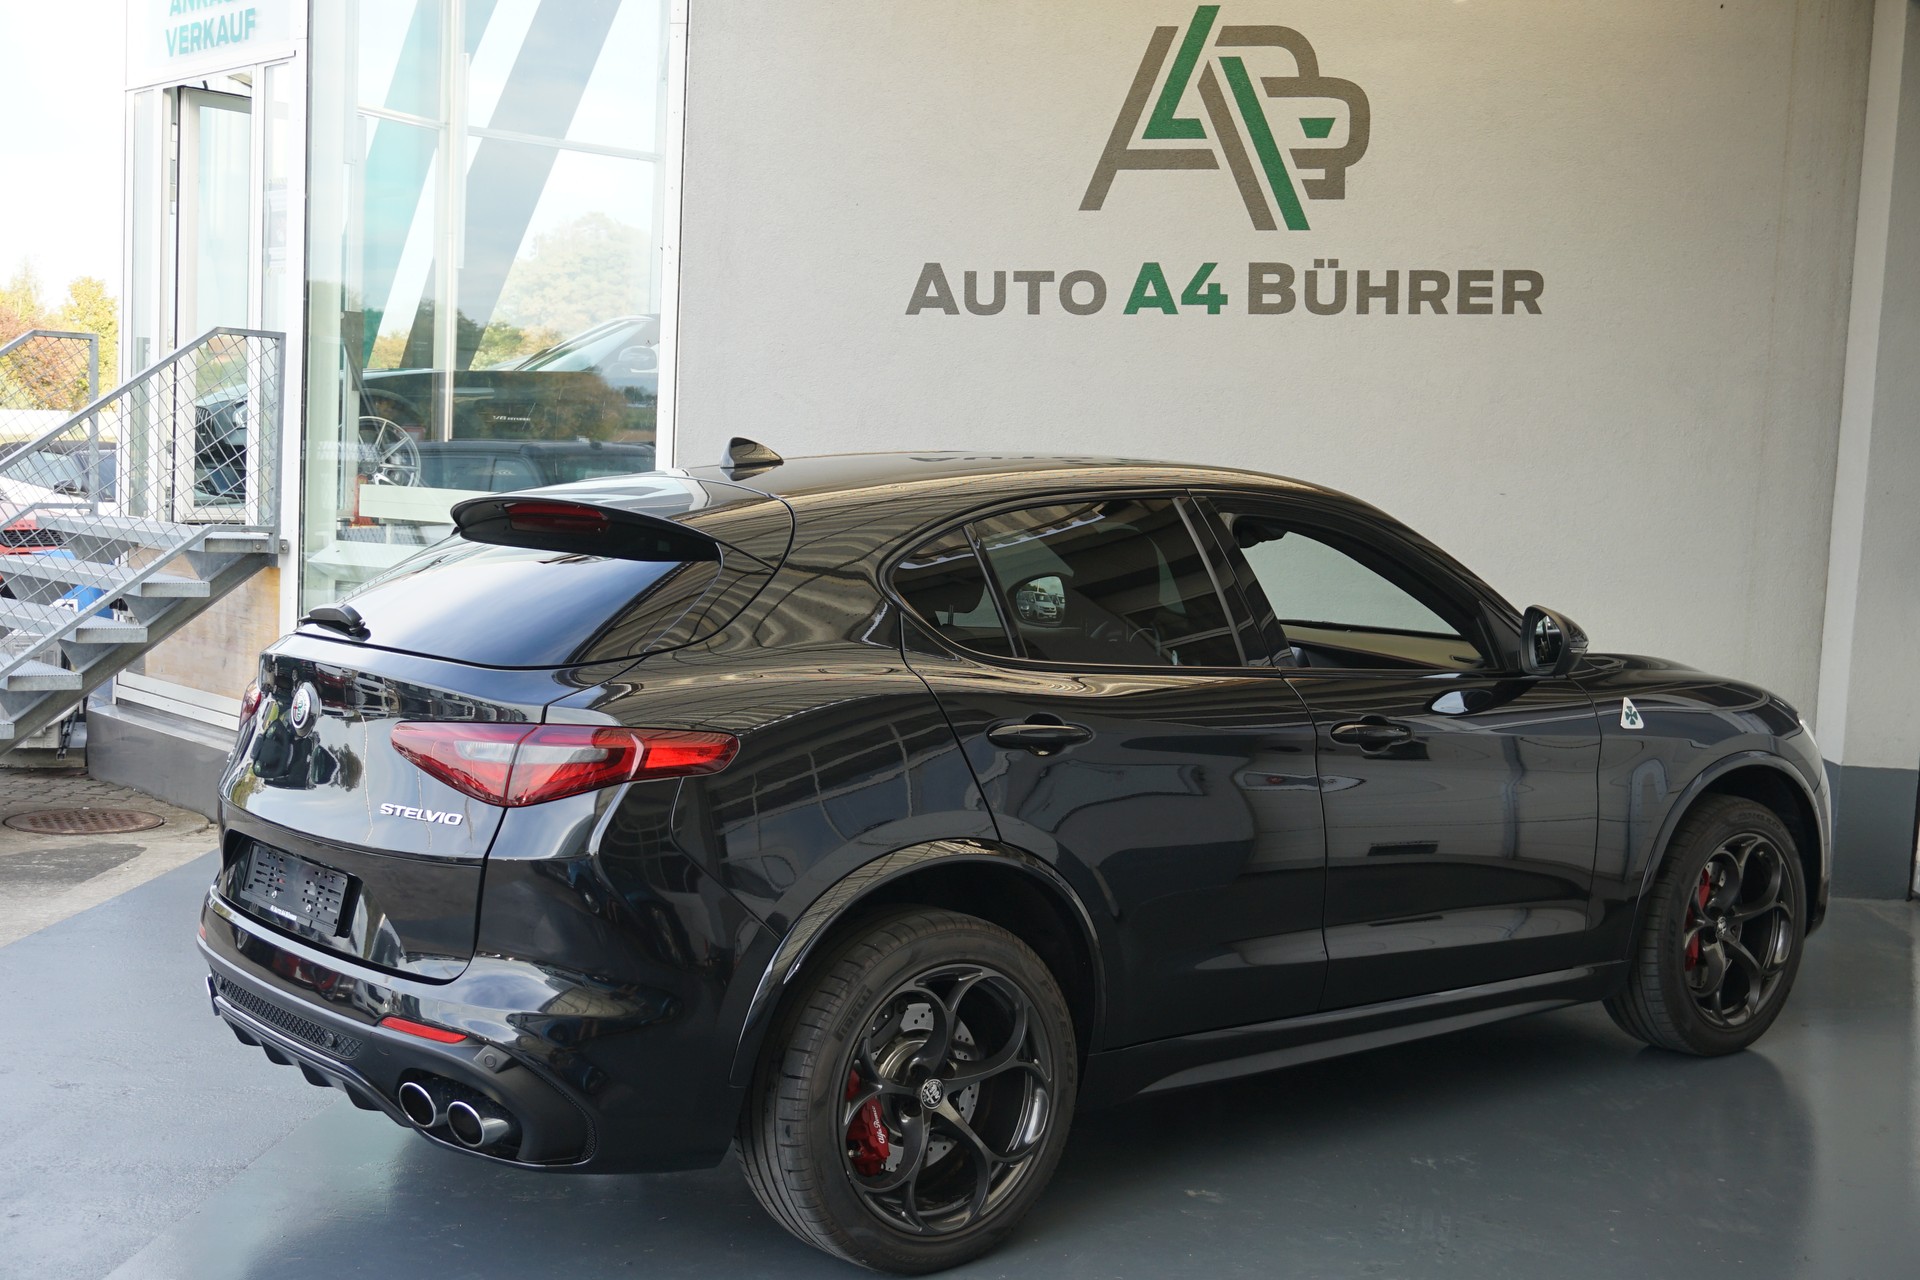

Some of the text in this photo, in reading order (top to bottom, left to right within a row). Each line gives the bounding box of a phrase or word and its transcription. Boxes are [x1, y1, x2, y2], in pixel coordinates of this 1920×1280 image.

[165, 8, 256, 57] VERKAUF
[1123, 262, 1228, 315] A4
[1248, 259, 1545, 315] BÜHRER
[380, 803, 463, 826] STELVIO
[832, 984, 873, 1042] PIRELLI
